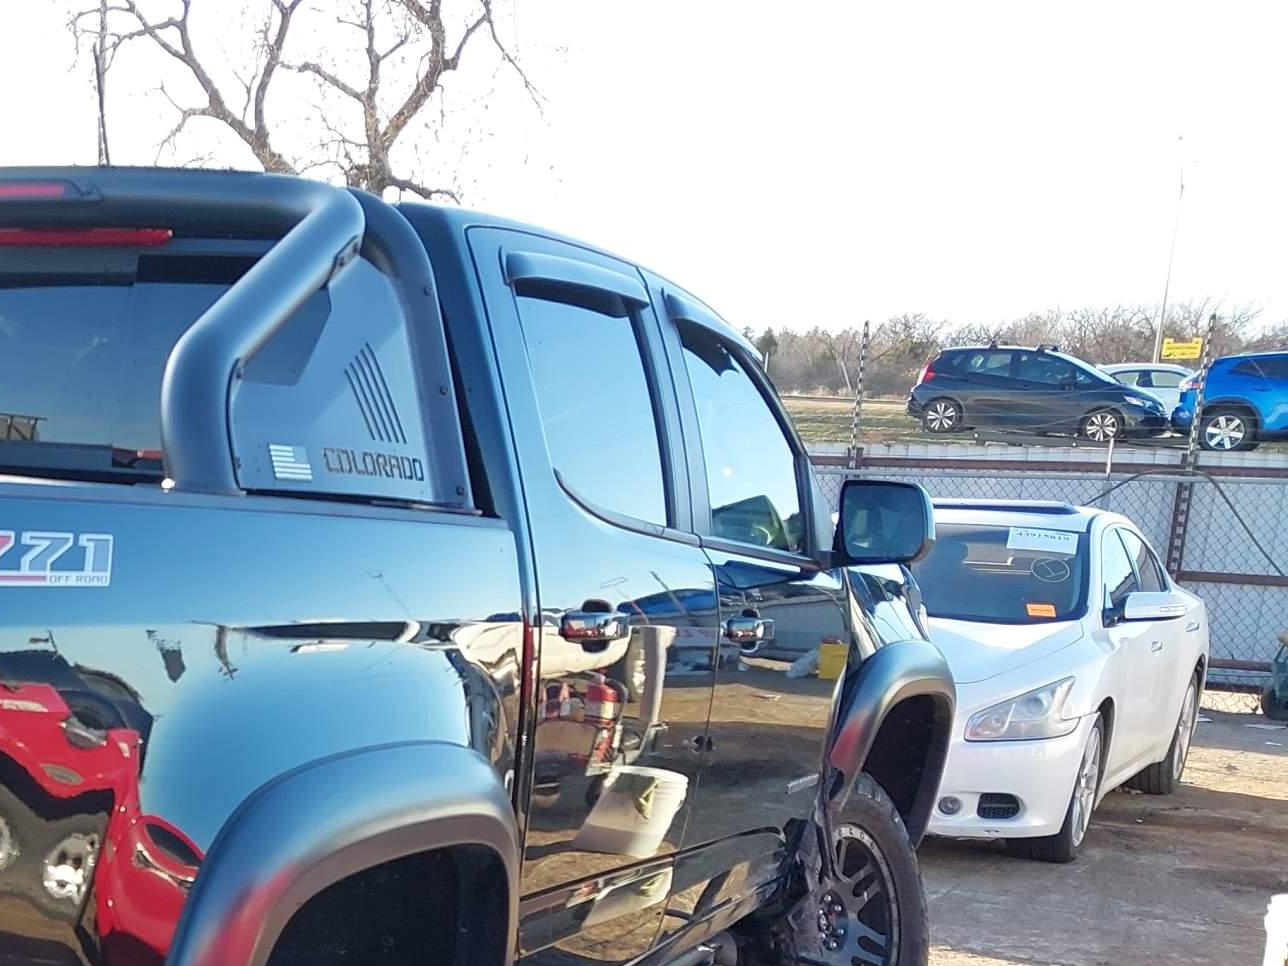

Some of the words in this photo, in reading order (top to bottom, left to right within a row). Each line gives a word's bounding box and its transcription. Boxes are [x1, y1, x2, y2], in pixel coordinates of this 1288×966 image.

[323, 448, 425, 481] COLORADO
[49, 575, 73, 584] OFF
[76, 575, 108, 584] ROAD
